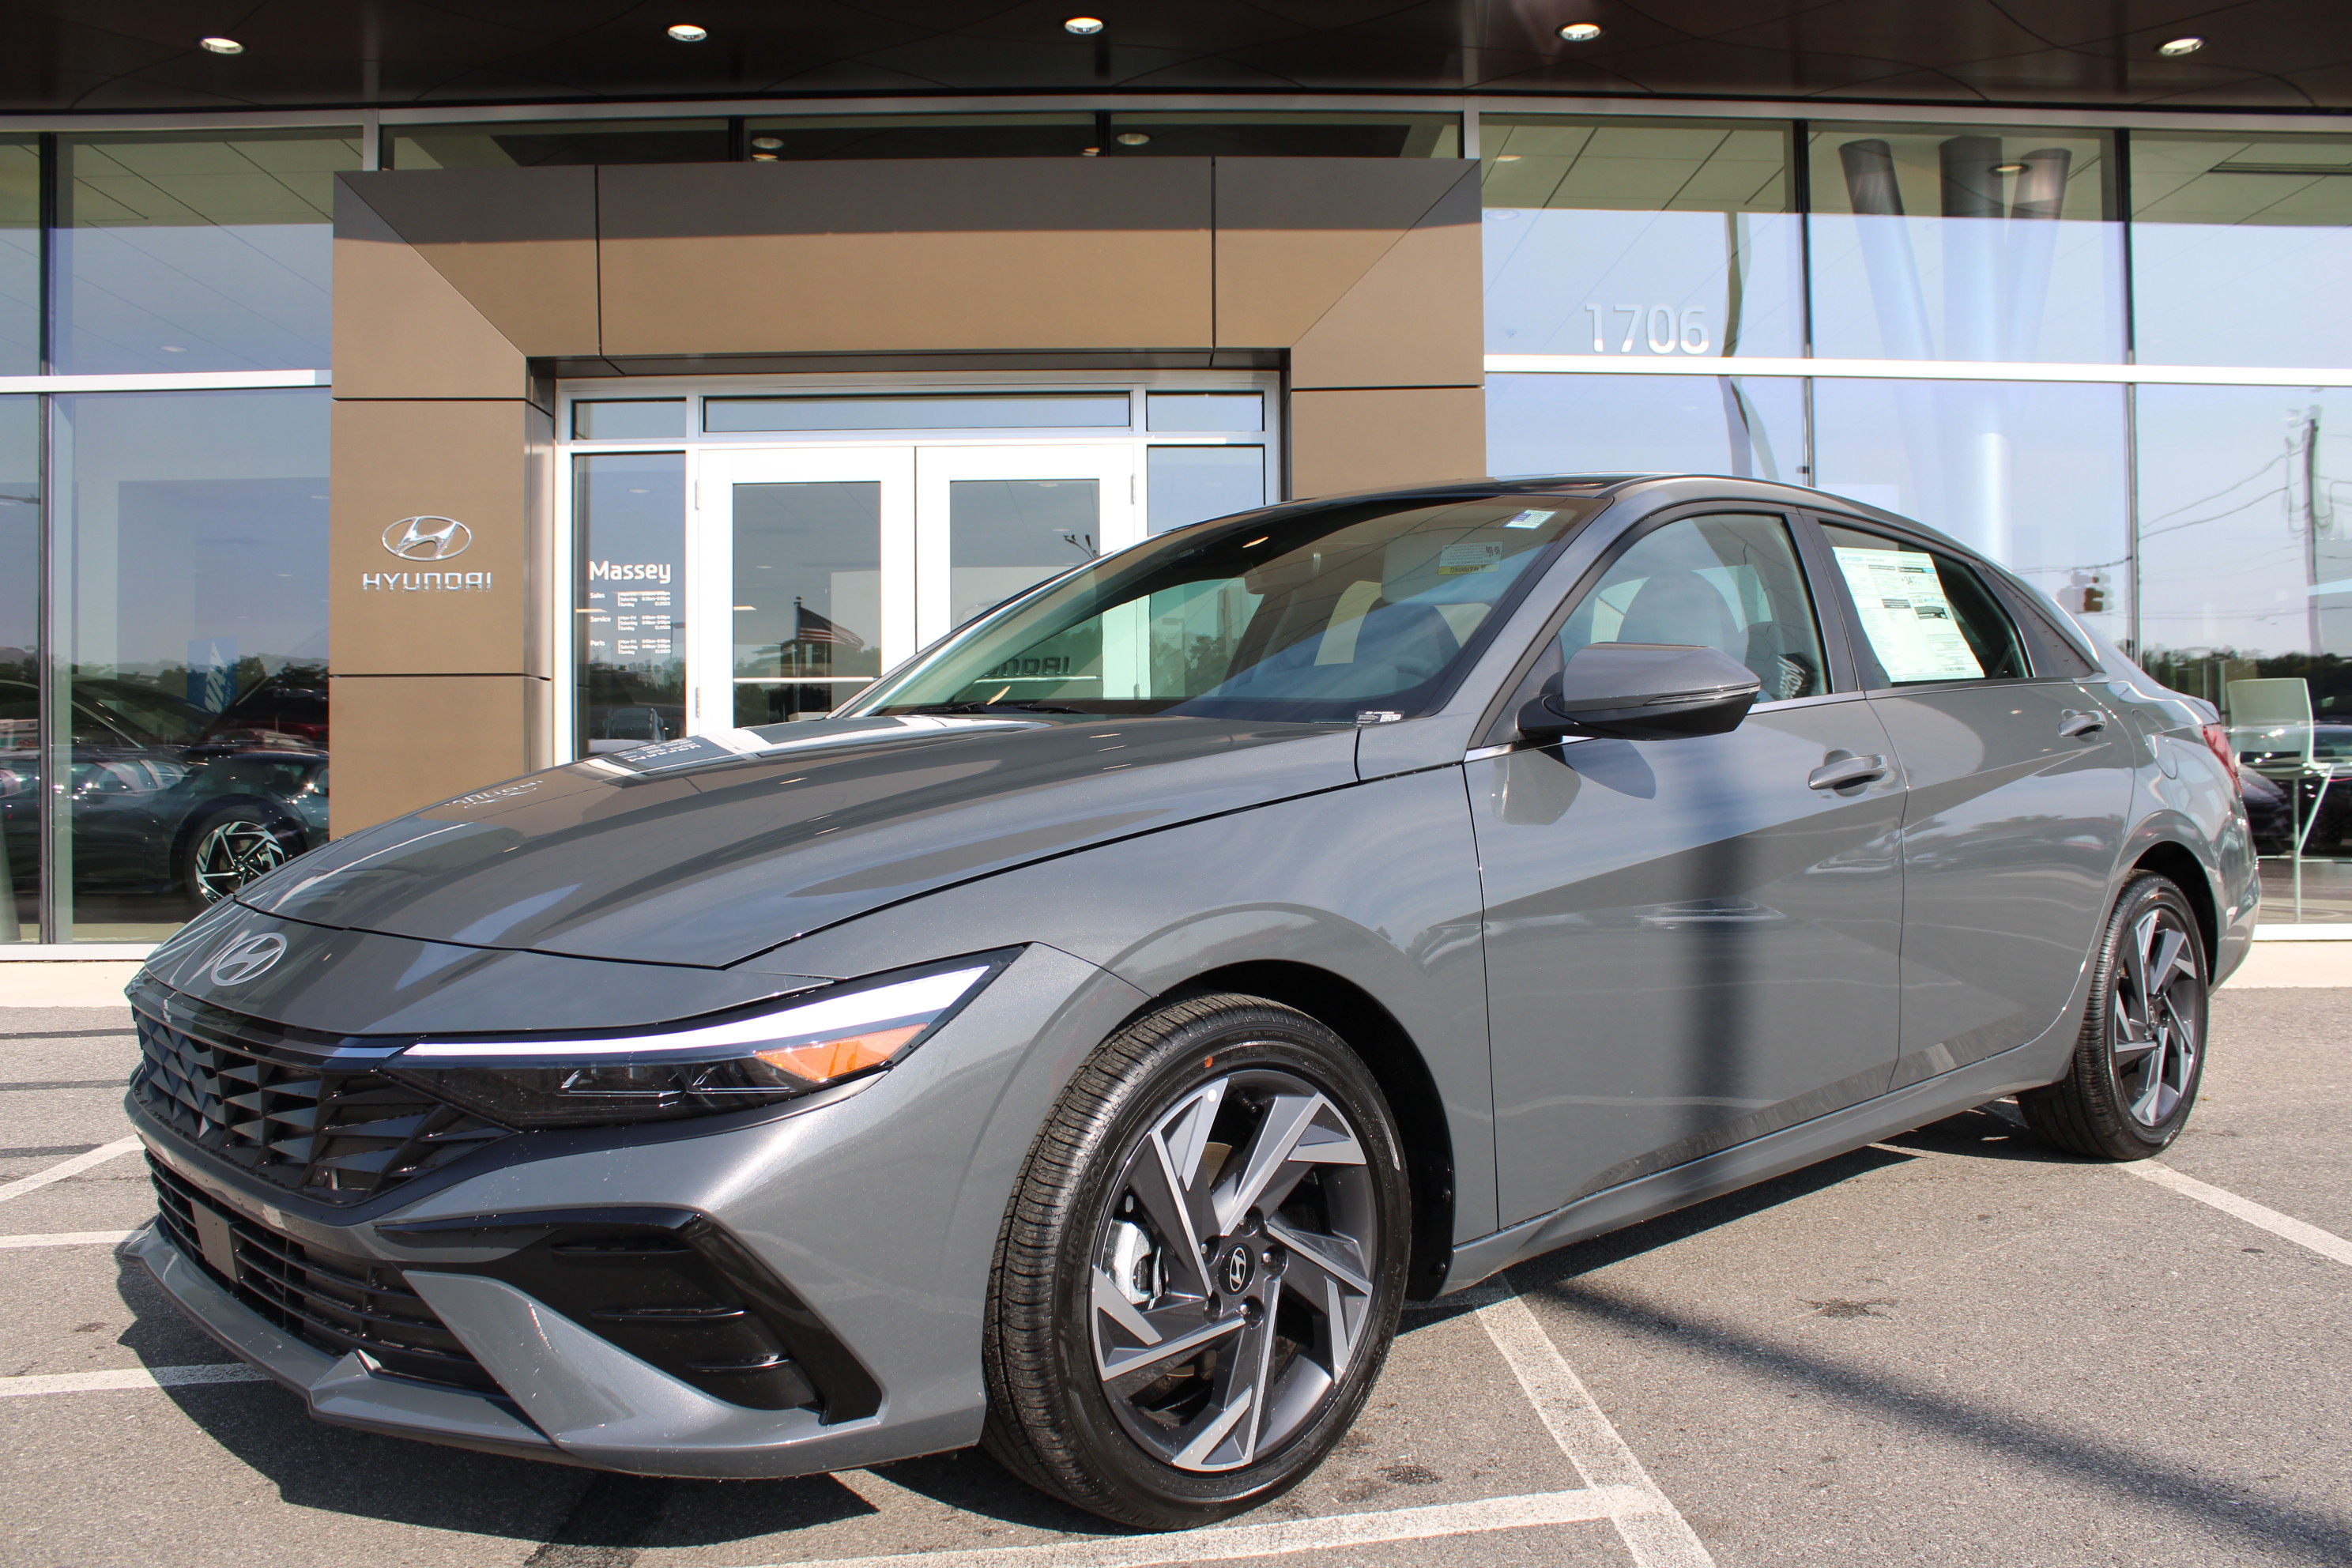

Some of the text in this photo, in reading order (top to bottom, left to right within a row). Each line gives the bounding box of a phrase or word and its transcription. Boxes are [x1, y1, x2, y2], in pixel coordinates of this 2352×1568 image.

[1585, 303, 1709, 354] 1706
[362, 571, 492, 592] HYUNDAI
[589, 560, 671, 584] Massey
